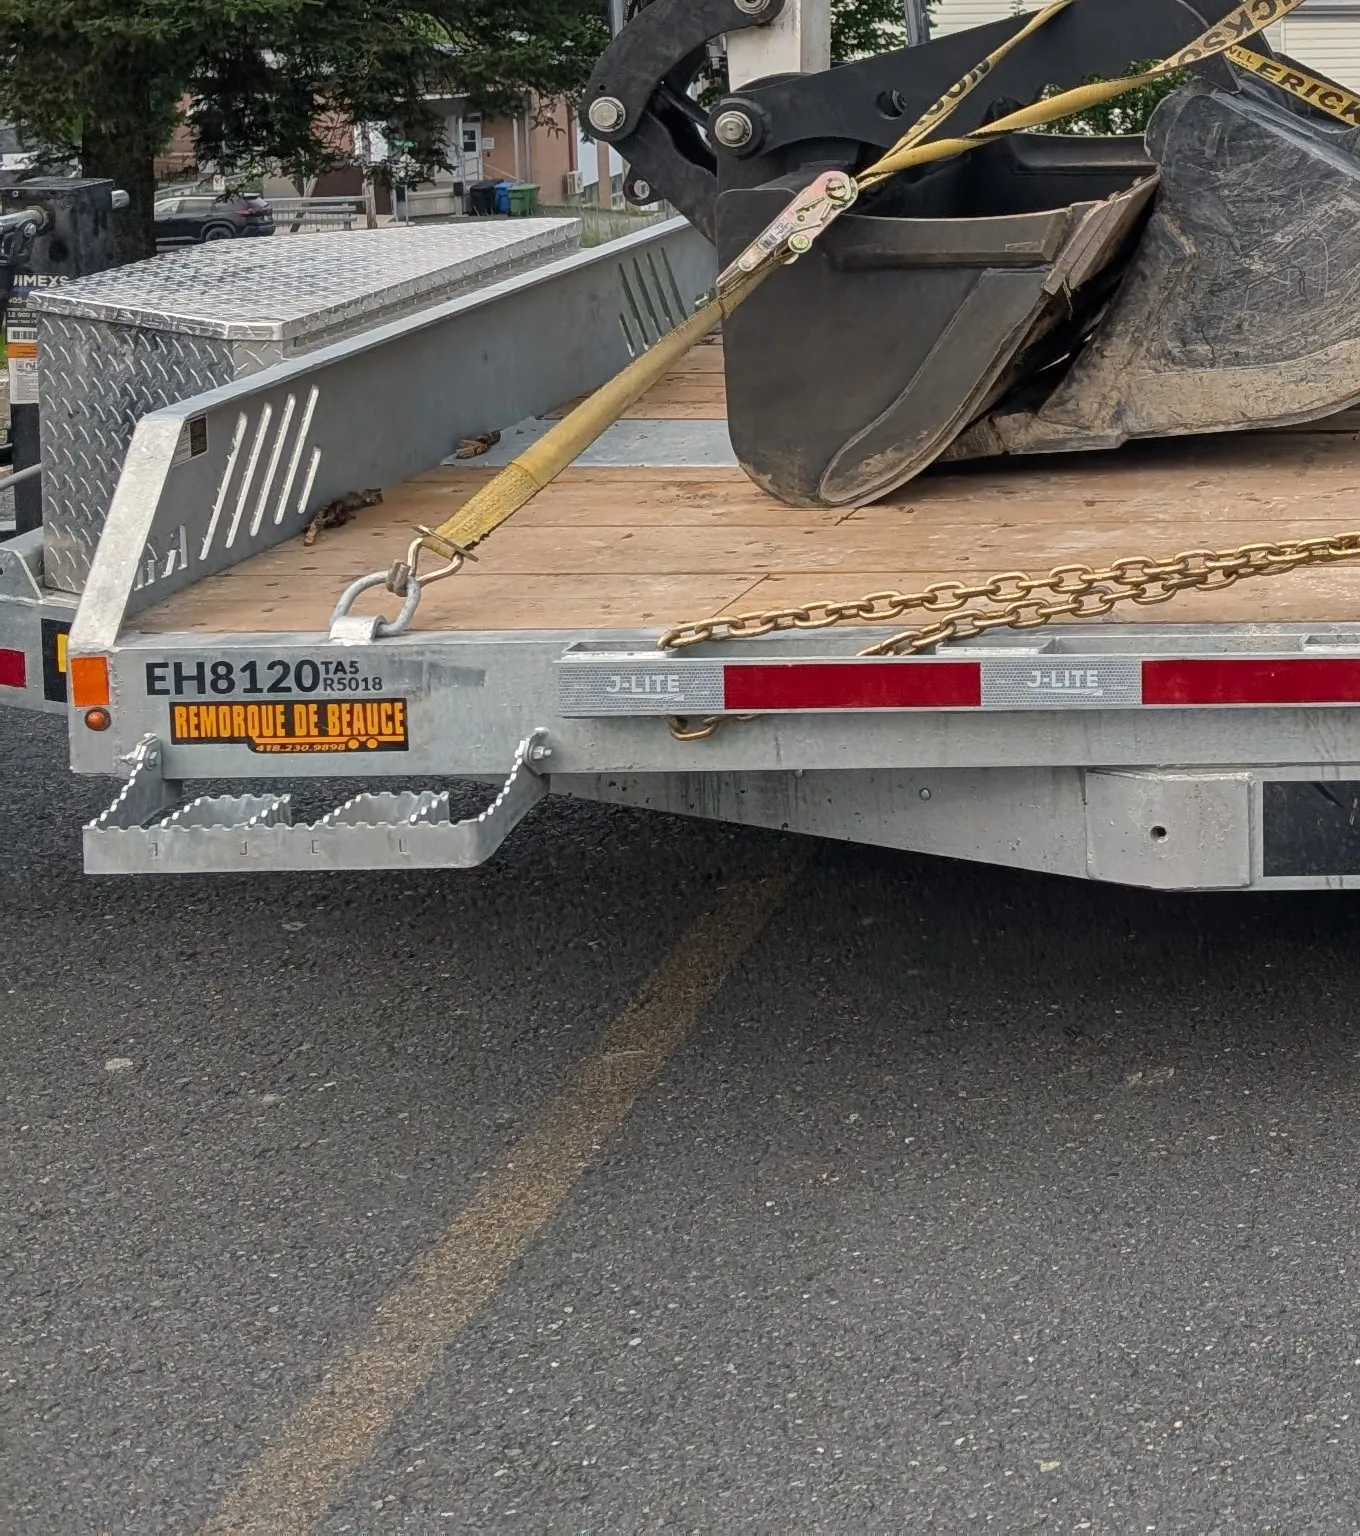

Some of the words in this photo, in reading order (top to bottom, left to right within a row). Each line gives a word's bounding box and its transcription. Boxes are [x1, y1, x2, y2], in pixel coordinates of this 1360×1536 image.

[145, 659, 320, 696] EH8120
[323, 676, 383, 692] R5018
[606, 674, 680, 693] J-LITE
[1027, 670, 1098, 688] J-LITE
[174, 704, 286, 739] REMORQUE
[294, 703, 318, 737] DE
[327, 702, 404, 736] BEAUCE
